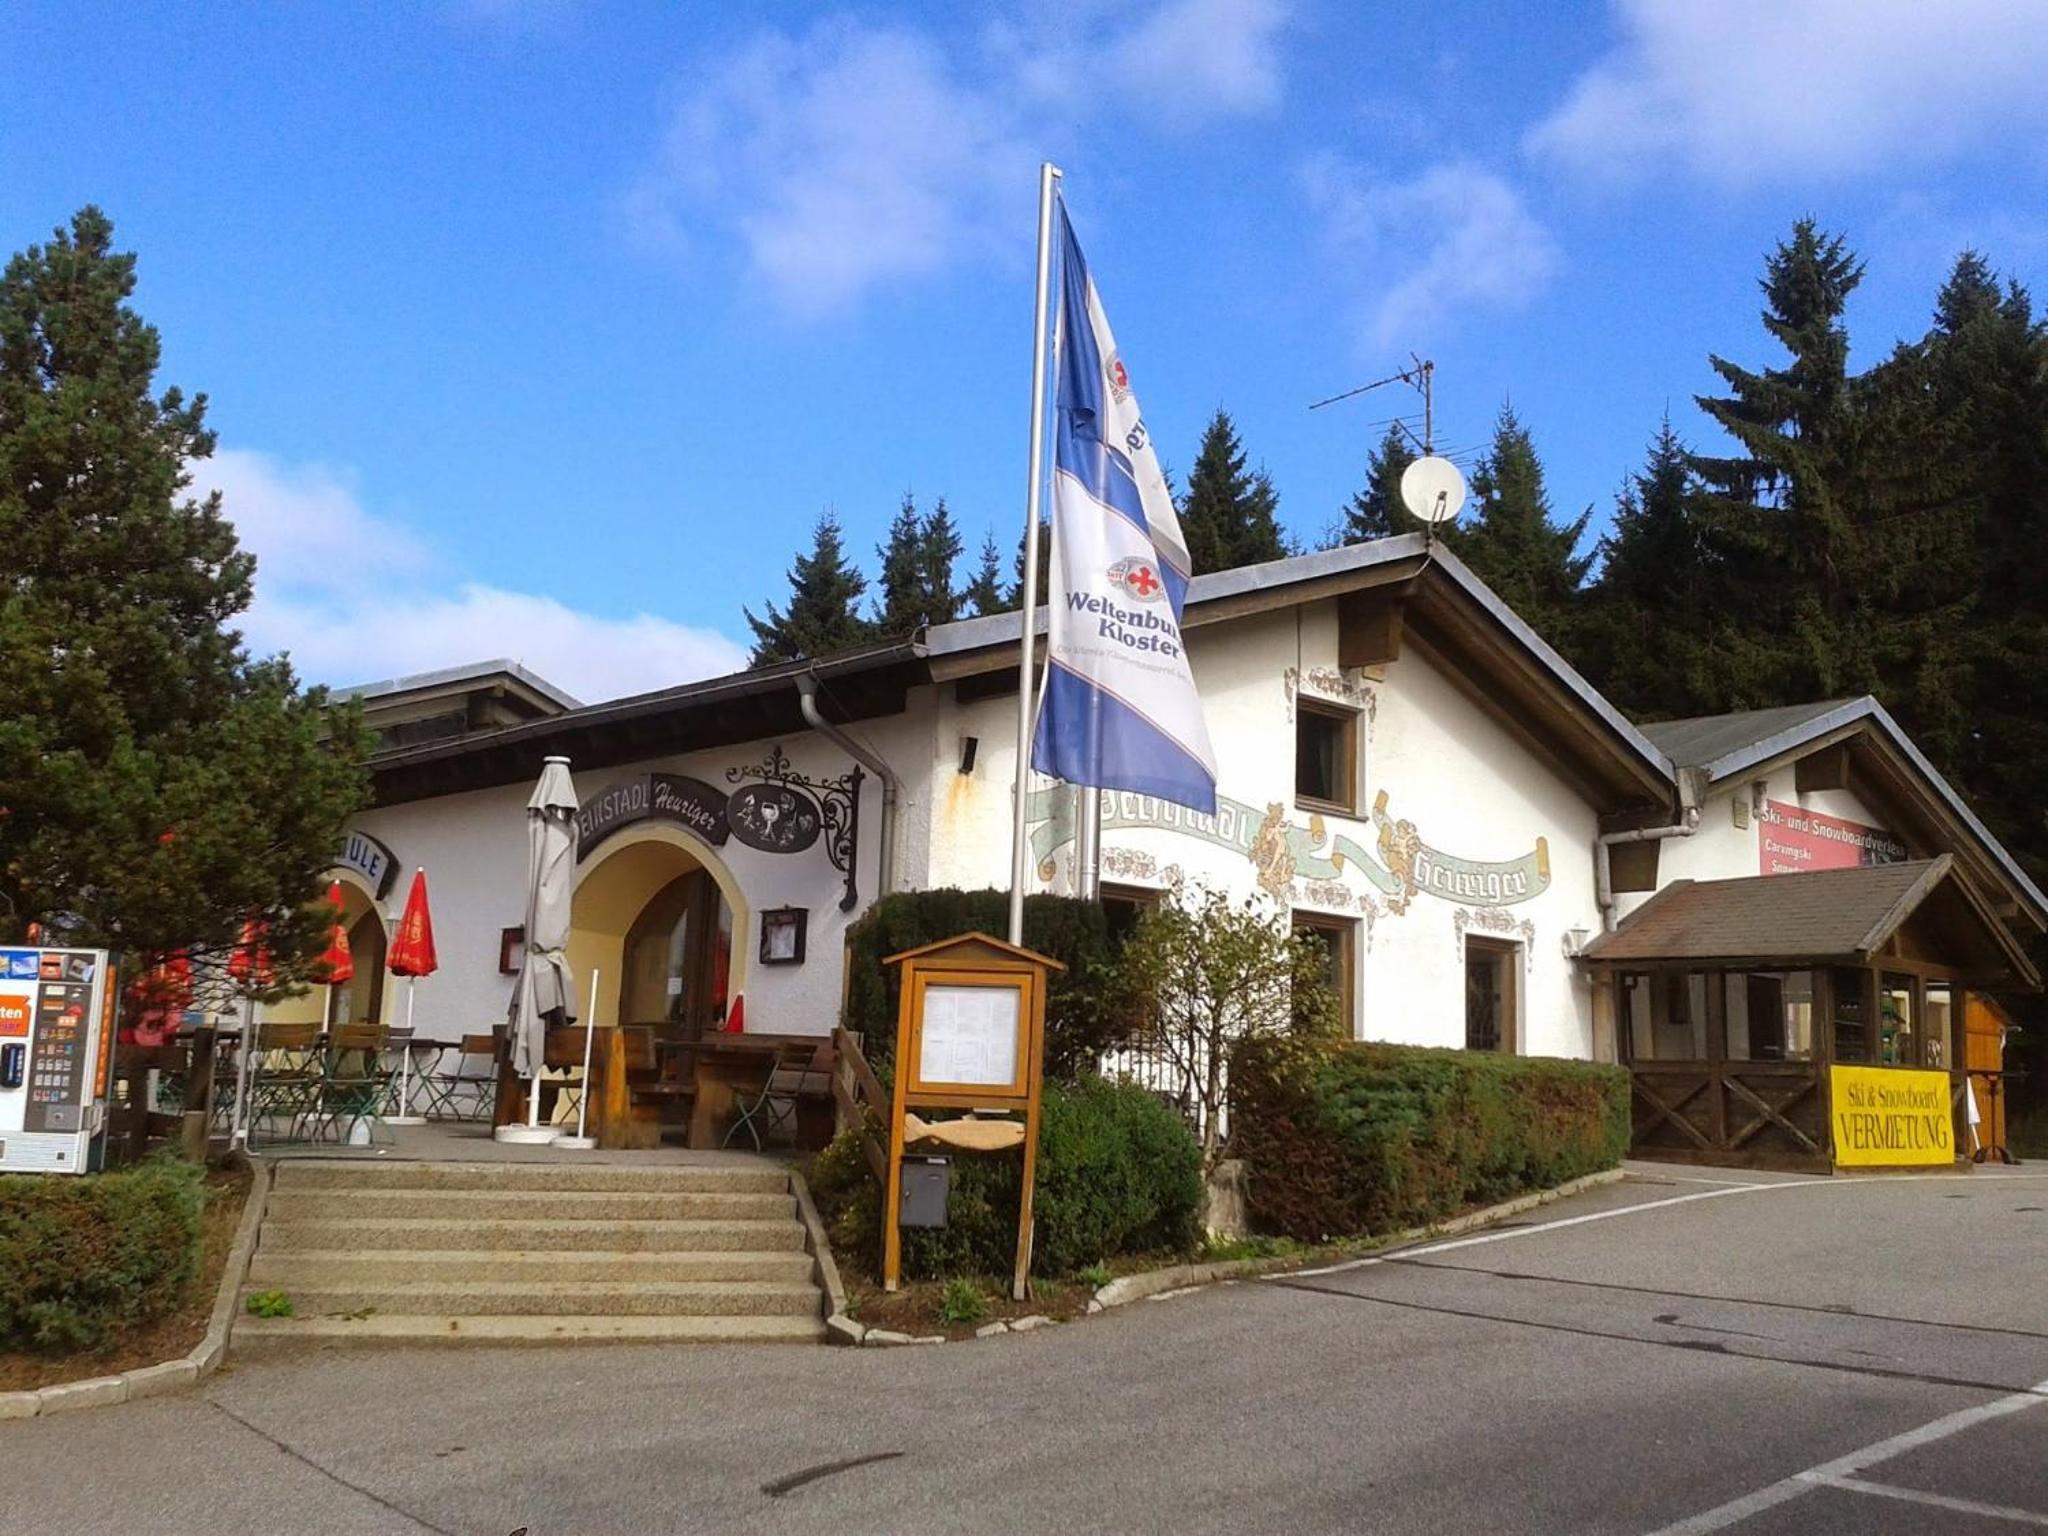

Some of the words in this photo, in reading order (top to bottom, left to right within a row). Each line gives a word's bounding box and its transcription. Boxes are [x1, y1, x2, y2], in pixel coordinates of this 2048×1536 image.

[1066, 591, 1180, 641] Weltenbu
[1098, 617, 1180, 660] Kloster
[1762, 806, 1784, 825] Ski-
[1788, 814, 1809, 833] und
[343, 837, 381, 877] ULE
[1848, 1081, 1865, 1108] Ski
[1868, 1085, 1876, 1108] &
[1878, 1083, 1939, 1110] Snowboard
[1840, 1113, 1948, 1150] VERMIETUNG
